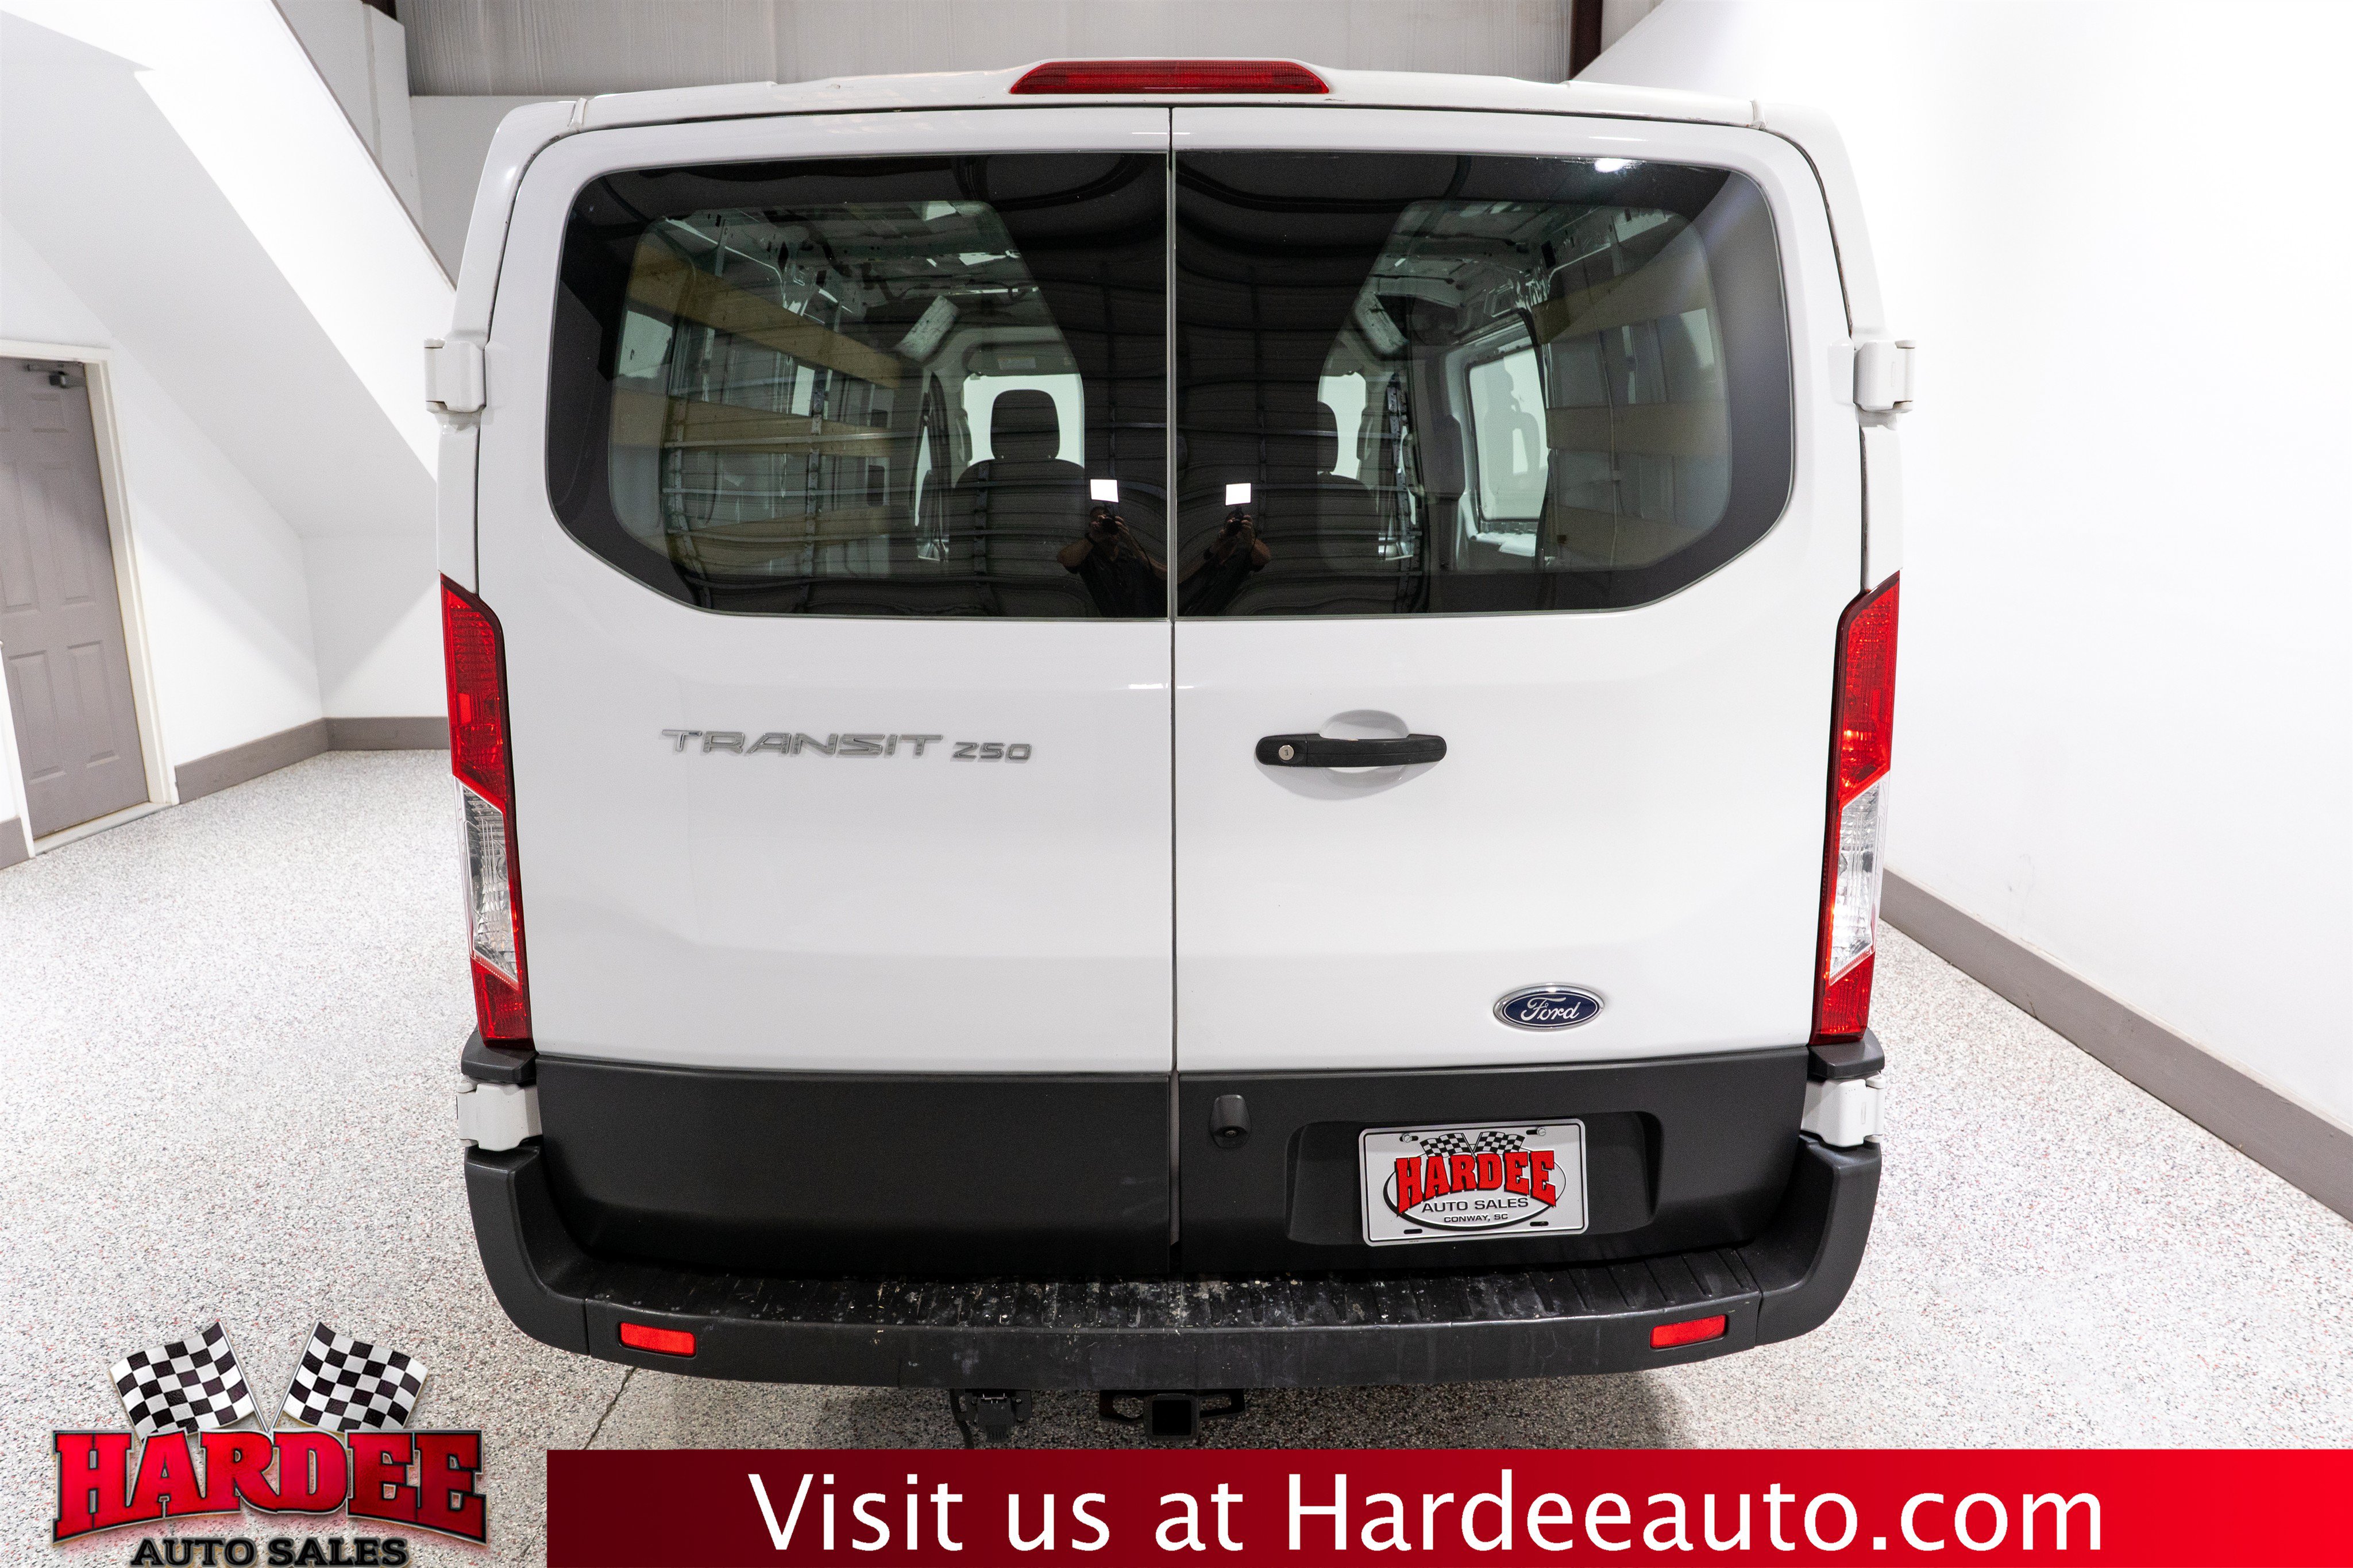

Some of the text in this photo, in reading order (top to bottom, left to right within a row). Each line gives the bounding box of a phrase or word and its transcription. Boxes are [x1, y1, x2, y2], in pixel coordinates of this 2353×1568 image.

[662, 729, 1032, 760] TRANSIT 250
[1521, 997, 1581, 1021] Ford
[1395, 1150, 1556, 1216] HARDEE
[1422, 1198, 1529, 1212] AUTO SALES
[1444, 1214, 1491, 1223] CONWAY,
